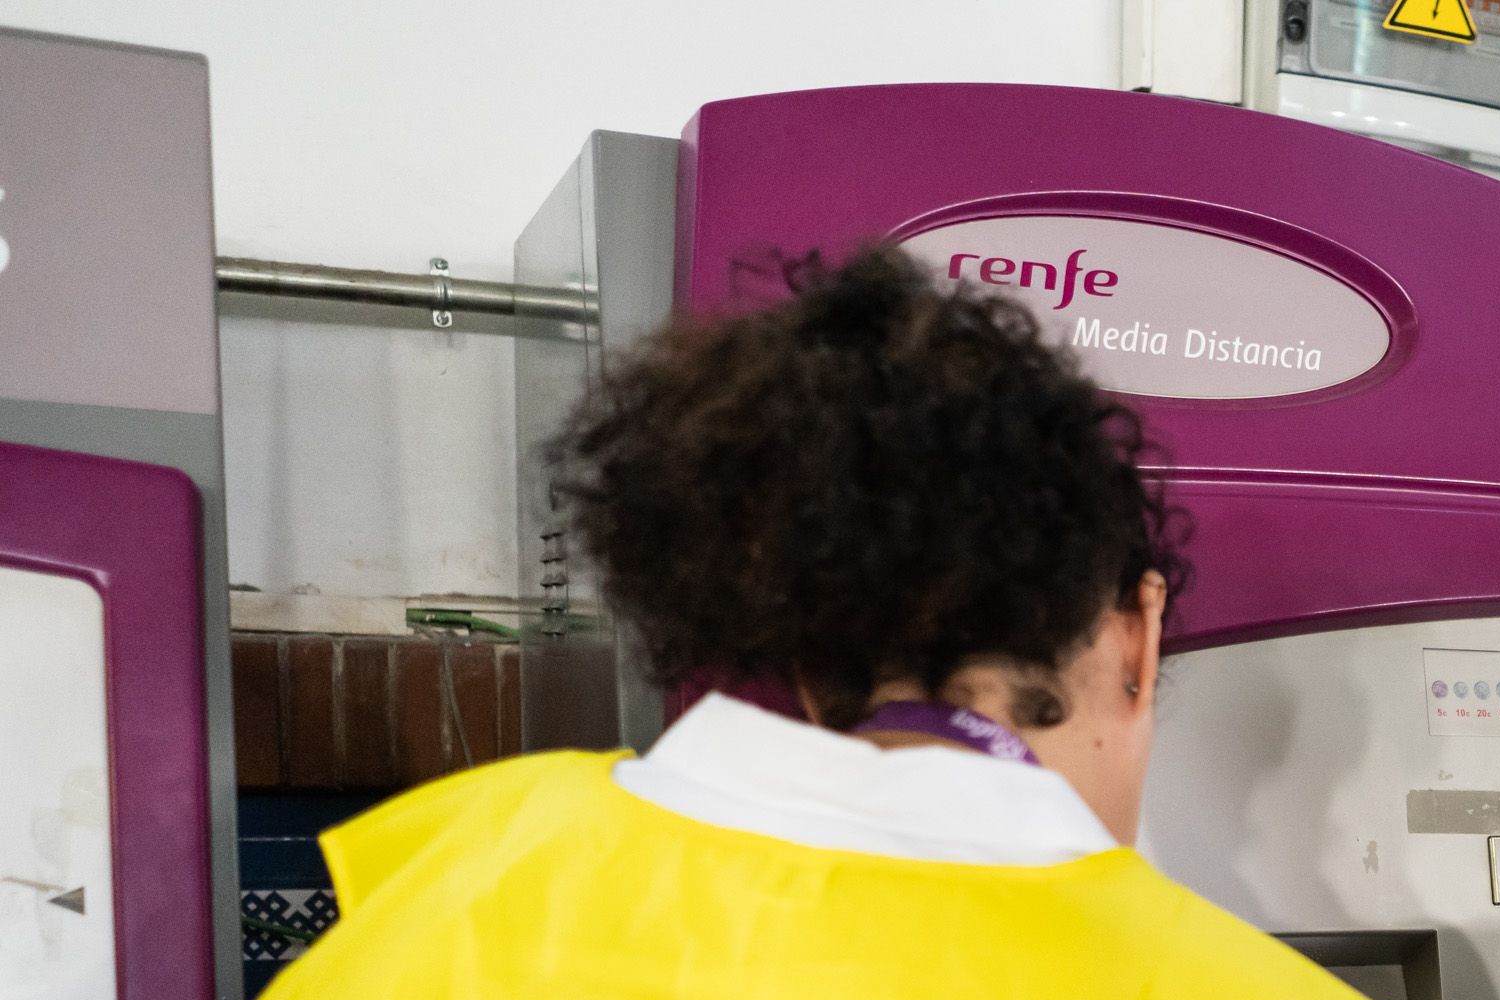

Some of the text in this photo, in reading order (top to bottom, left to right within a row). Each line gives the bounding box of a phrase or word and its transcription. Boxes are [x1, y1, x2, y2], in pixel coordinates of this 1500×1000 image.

[947, 249, 1120, 310] renfe
[1072, 316, 1322, 372] Media Distancia
